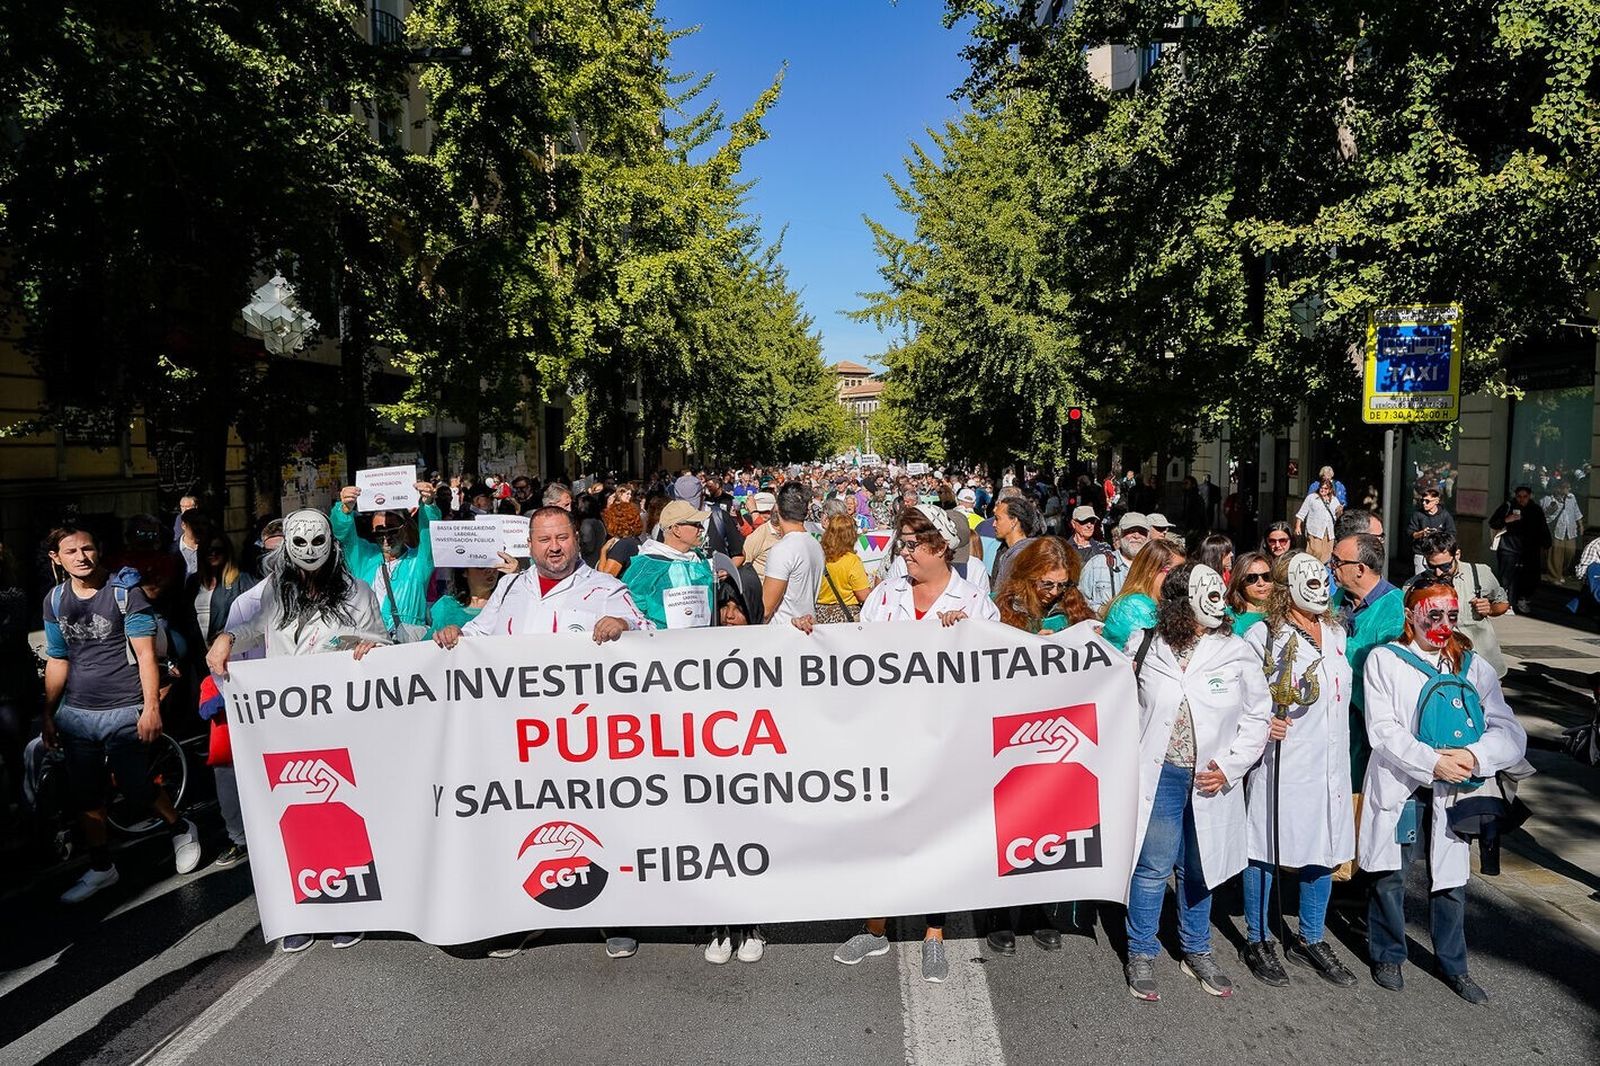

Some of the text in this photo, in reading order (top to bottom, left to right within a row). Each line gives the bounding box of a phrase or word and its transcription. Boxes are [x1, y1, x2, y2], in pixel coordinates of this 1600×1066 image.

[1390, 366, 1438, 381] TAXI
[1370, 411, 1381, 419] DE
[1384, 411, 1404, 419] 7:30
[1415, 410, 1440, 419] 22:00
[233, 640, 1113, 724] ¡¡POR UNA INVESTIGACIÓN BIOSANITARIA
[516, 703, 788, 763] PÚBLICA
[433, 768, 889, 818] Y SALARIOS DIGNOS!!
[1005, 829, 1094, 869] CGT
[298, 865, 371, 898] CGT
[540, 866, 591, 890] CGT
